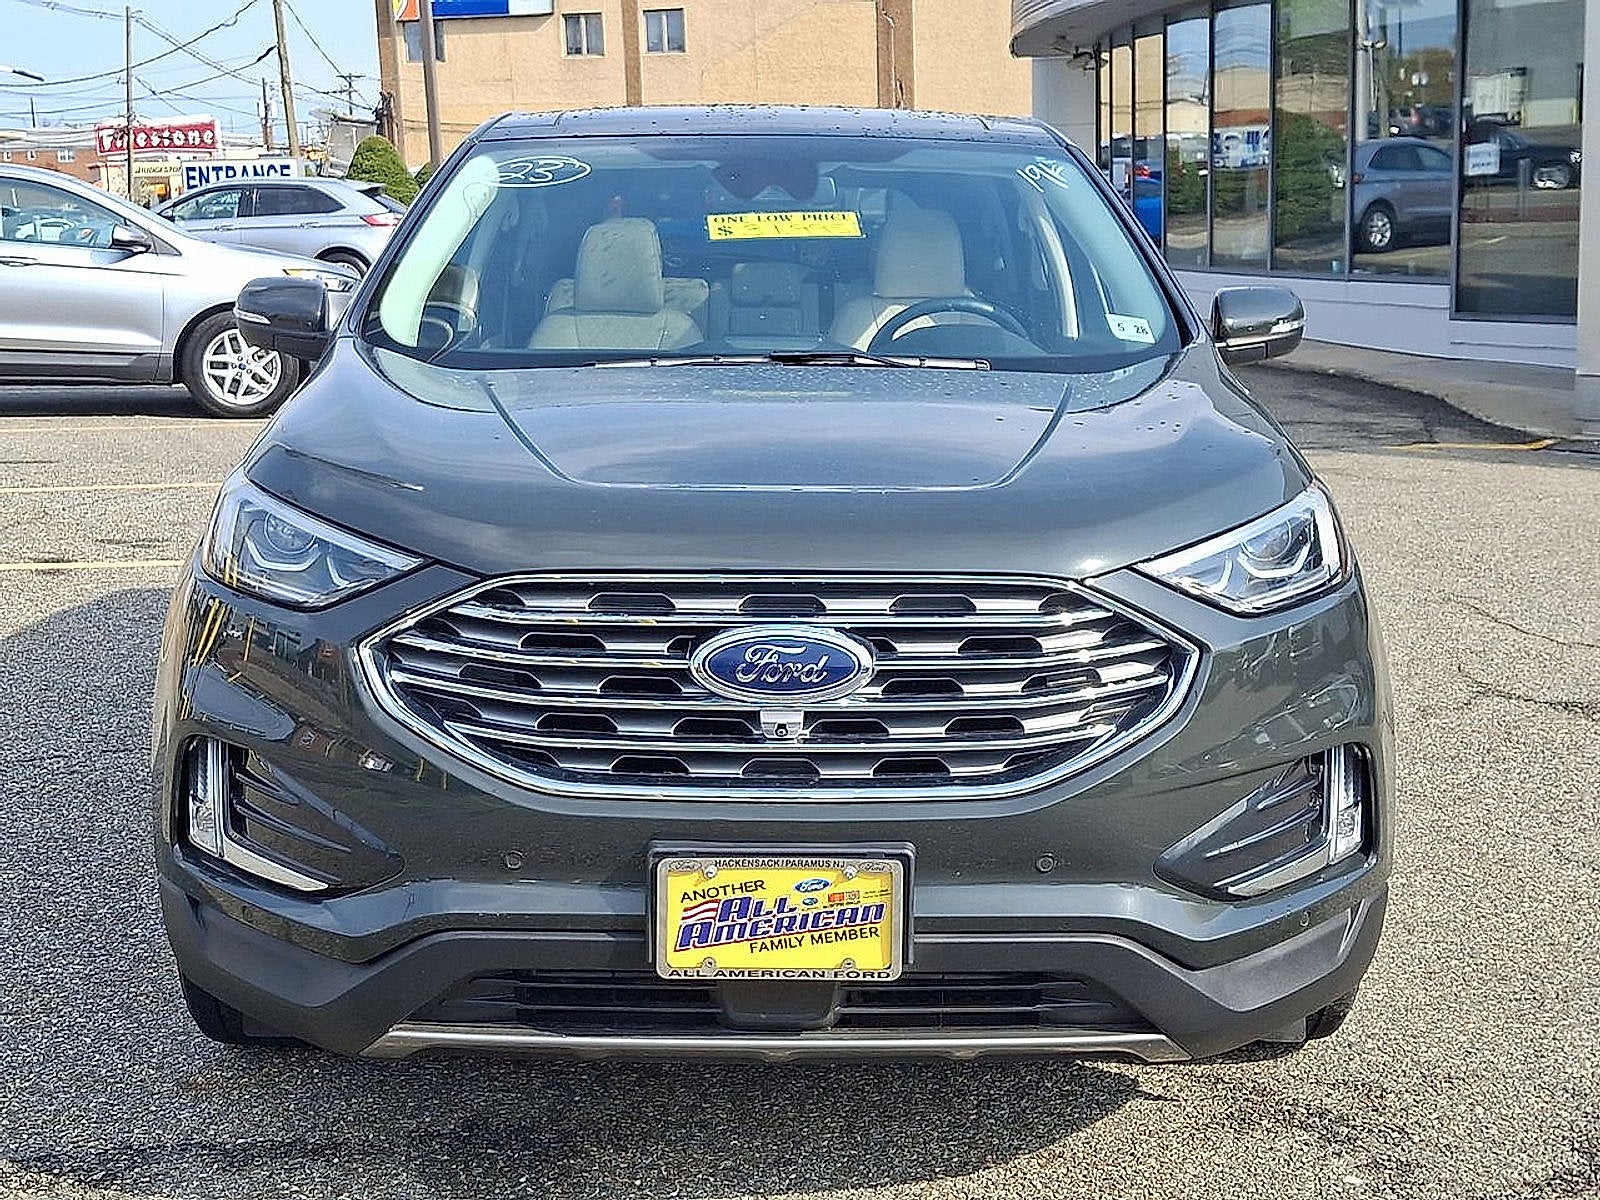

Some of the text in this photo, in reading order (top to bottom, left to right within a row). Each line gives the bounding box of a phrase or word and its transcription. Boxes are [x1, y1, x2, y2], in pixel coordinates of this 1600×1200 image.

[713, 212, 850, 224] ONE LOW PRICE
[736, 643, 830, 683] Ford
[680, 879, 766, 904] ANOTHER
[718, 896, 798, 923] ALL
[678, 903, 886, 948] AMERICAN
[749, 926, 880, 954] FAMILY MEMBER
[668, 969, 890, 979] ALL AMERICAN FORD
